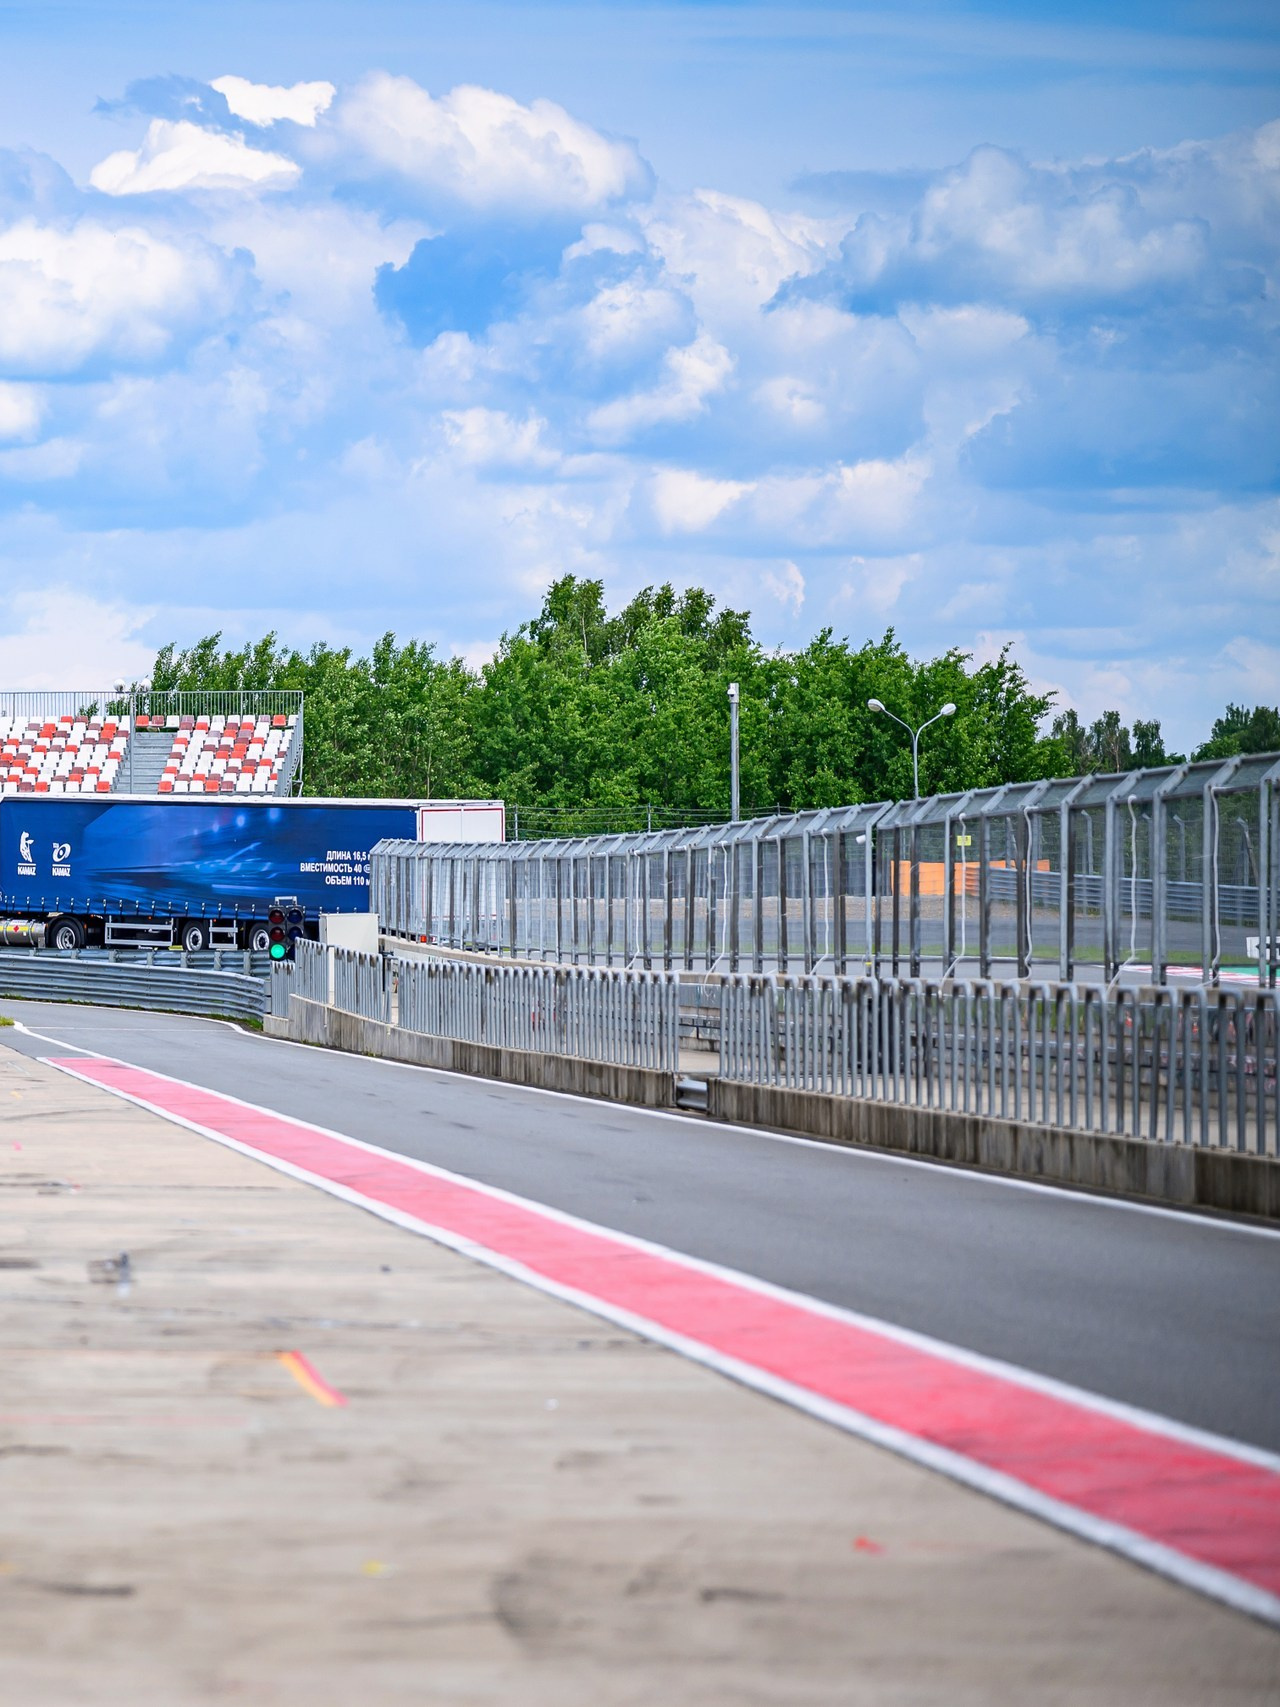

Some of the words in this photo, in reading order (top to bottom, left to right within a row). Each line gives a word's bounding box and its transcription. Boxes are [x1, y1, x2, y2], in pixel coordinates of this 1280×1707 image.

[326, 850, 351, 861] ДЛИНА
[353, 851, 366, 862] 16,5
[300, 862, 352, 873] ВМЕСТИМОСТЬ
[354, 864, 362, 873] 40
[325, 875, 352, 885] ОБЪЕМ
[353, 876, 364, 886] 110
